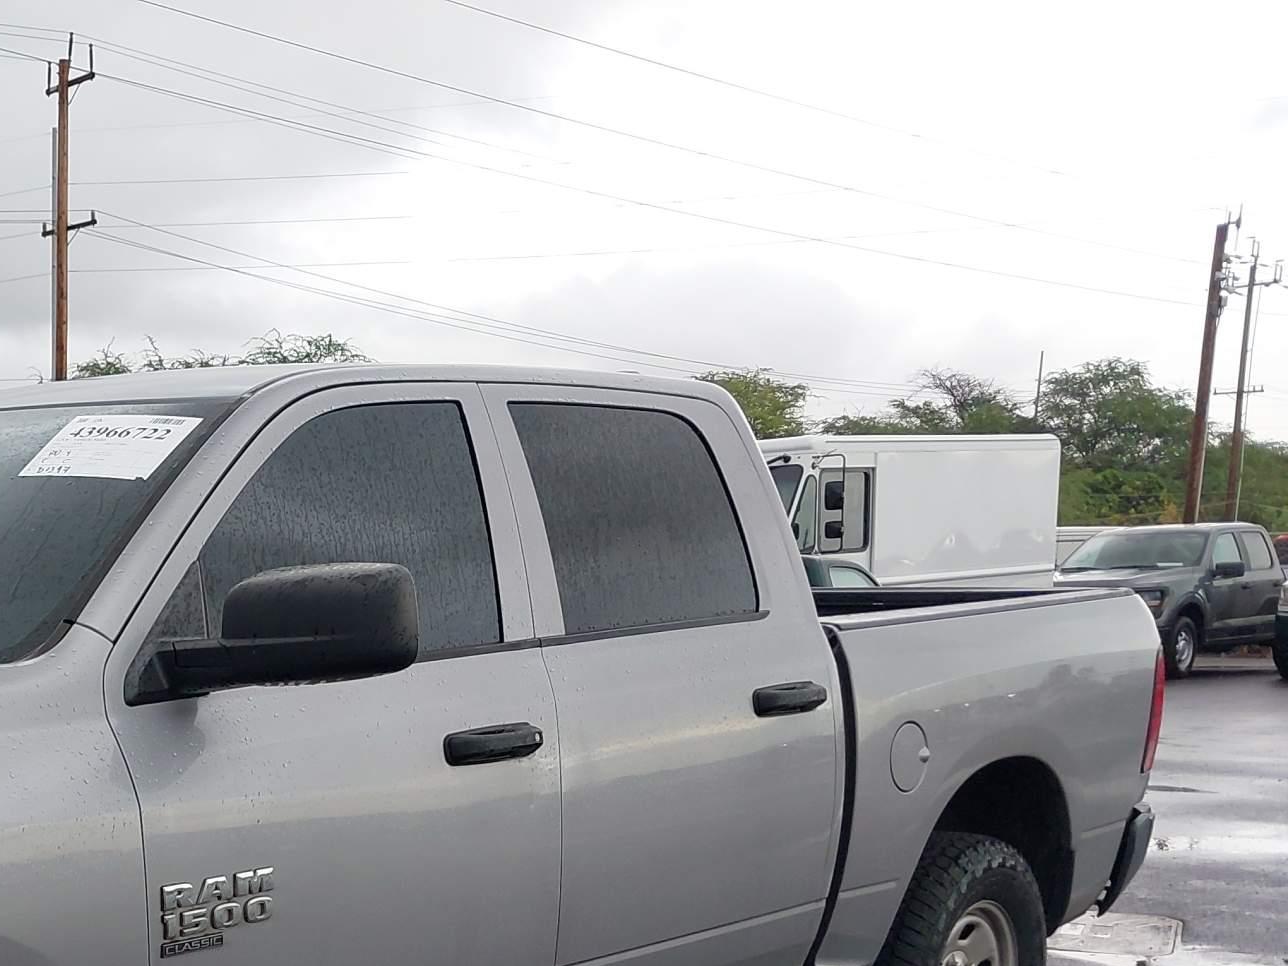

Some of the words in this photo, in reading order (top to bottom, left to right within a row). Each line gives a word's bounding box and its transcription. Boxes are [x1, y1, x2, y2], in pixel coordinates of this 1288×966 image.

[70, 426, 172, 440] 43966722
[160, 866, 274, 911] RAM
[160, 896, 273, 940] 1500
[165, 937, 223, 956] CLASSIC
